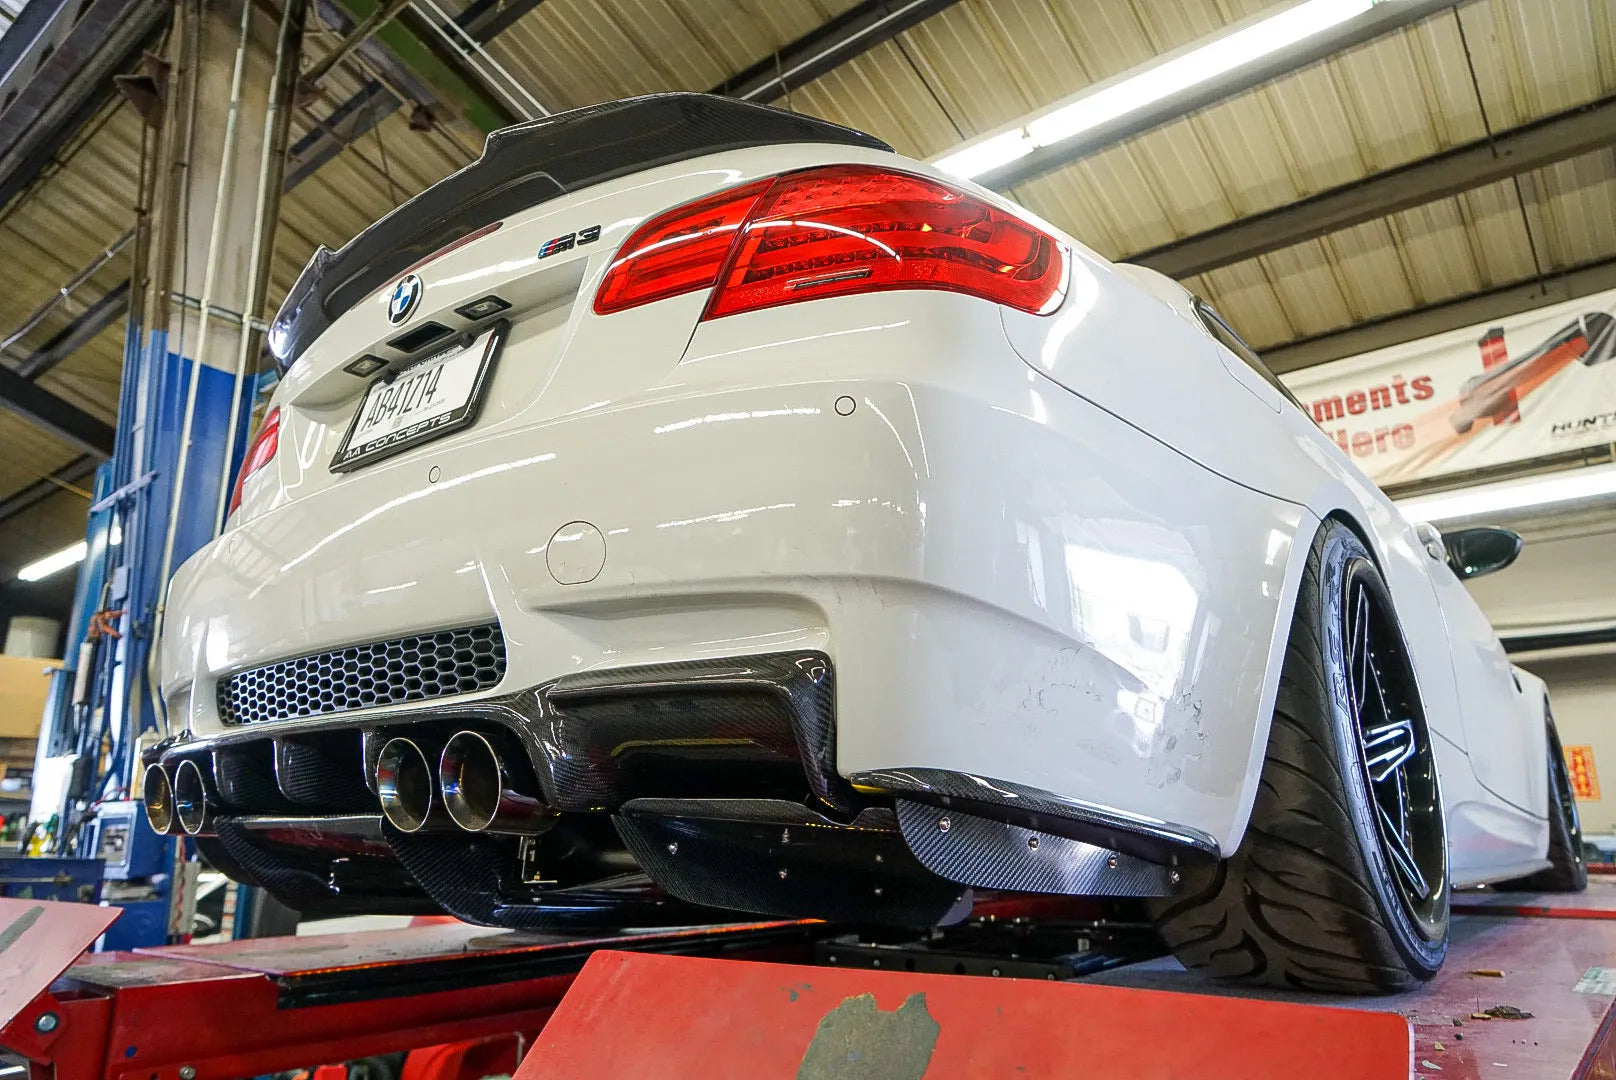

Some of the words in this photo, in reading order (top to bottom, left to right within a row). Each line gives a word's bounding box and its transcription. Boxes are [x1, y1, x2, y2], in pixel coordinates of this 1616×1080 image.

[537, 224, 602, 260] M3
[1304, 373, 1435, 424] ments
[365, 411, 453, 452] CONCEPTS
[1552, 411, 1616, 433] HUNT
